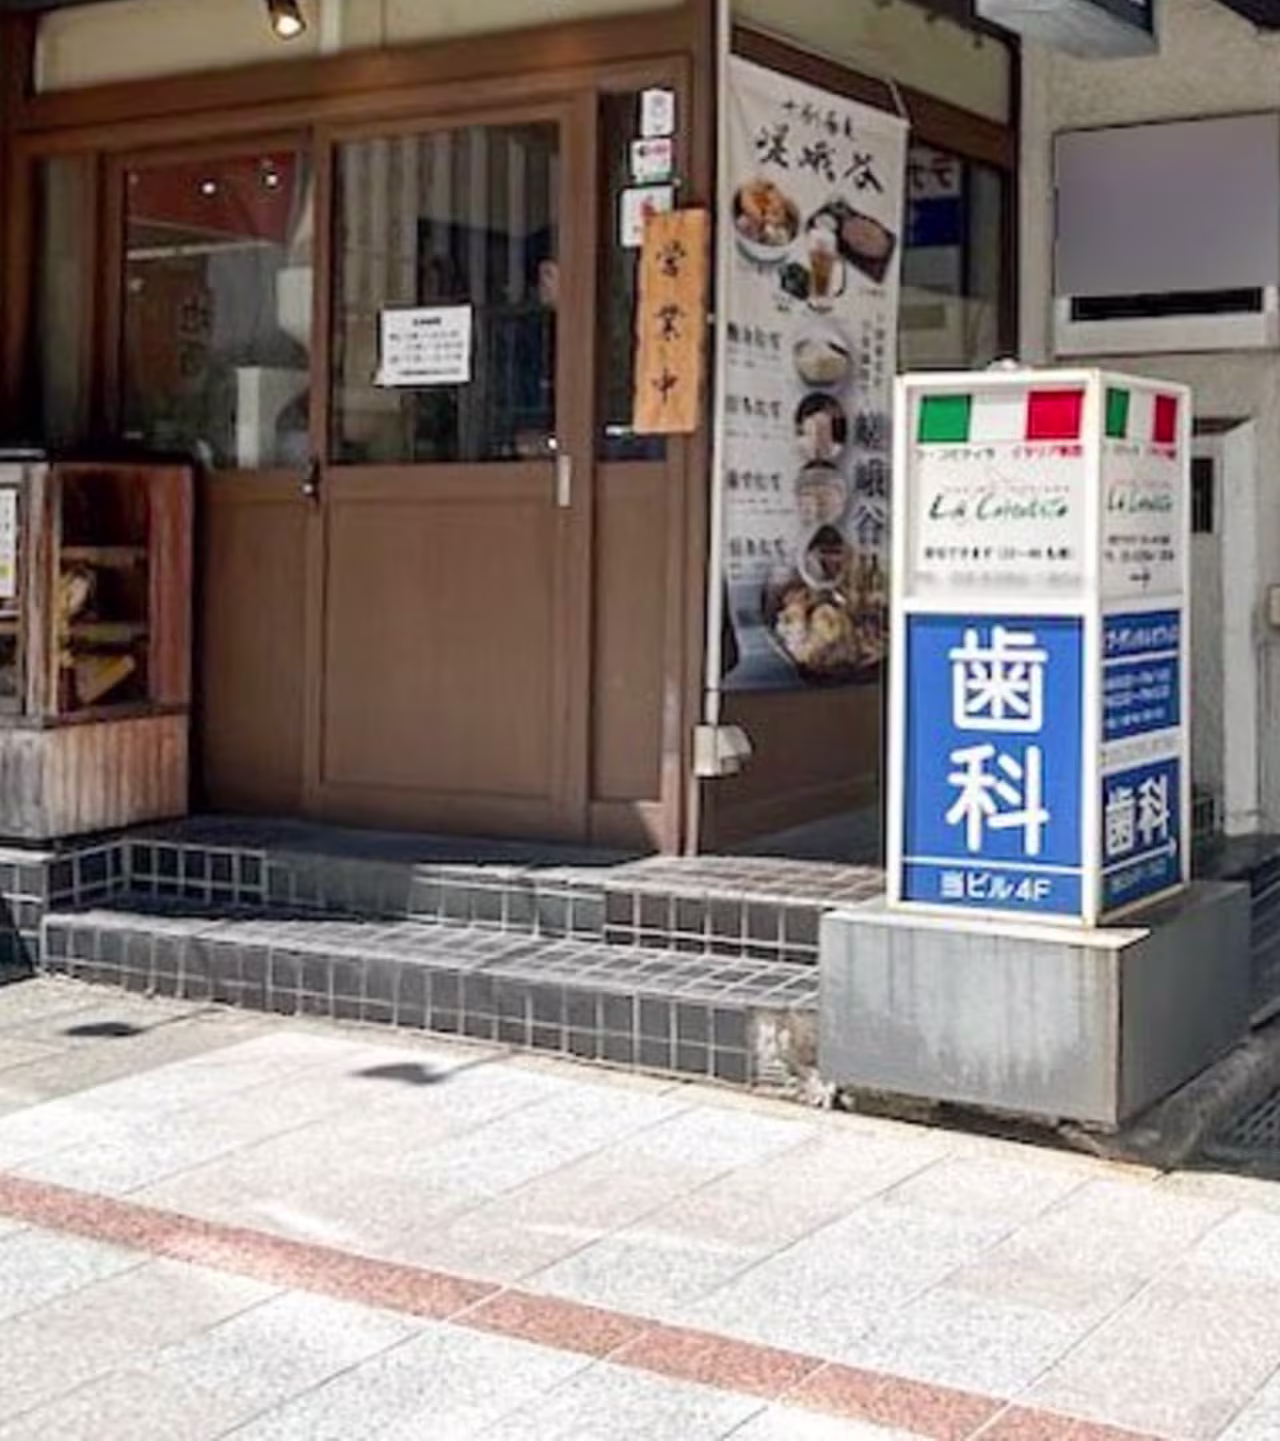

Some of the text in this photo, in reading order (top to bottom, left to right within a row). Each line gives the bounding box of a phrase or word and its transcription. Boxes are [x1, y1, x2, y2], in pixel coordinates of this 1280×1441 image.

[652, 239, 687, 405] 営業中
[947, 625, 1049, 856] 歯科
[1106, 774, 1170, 856] 歯科
